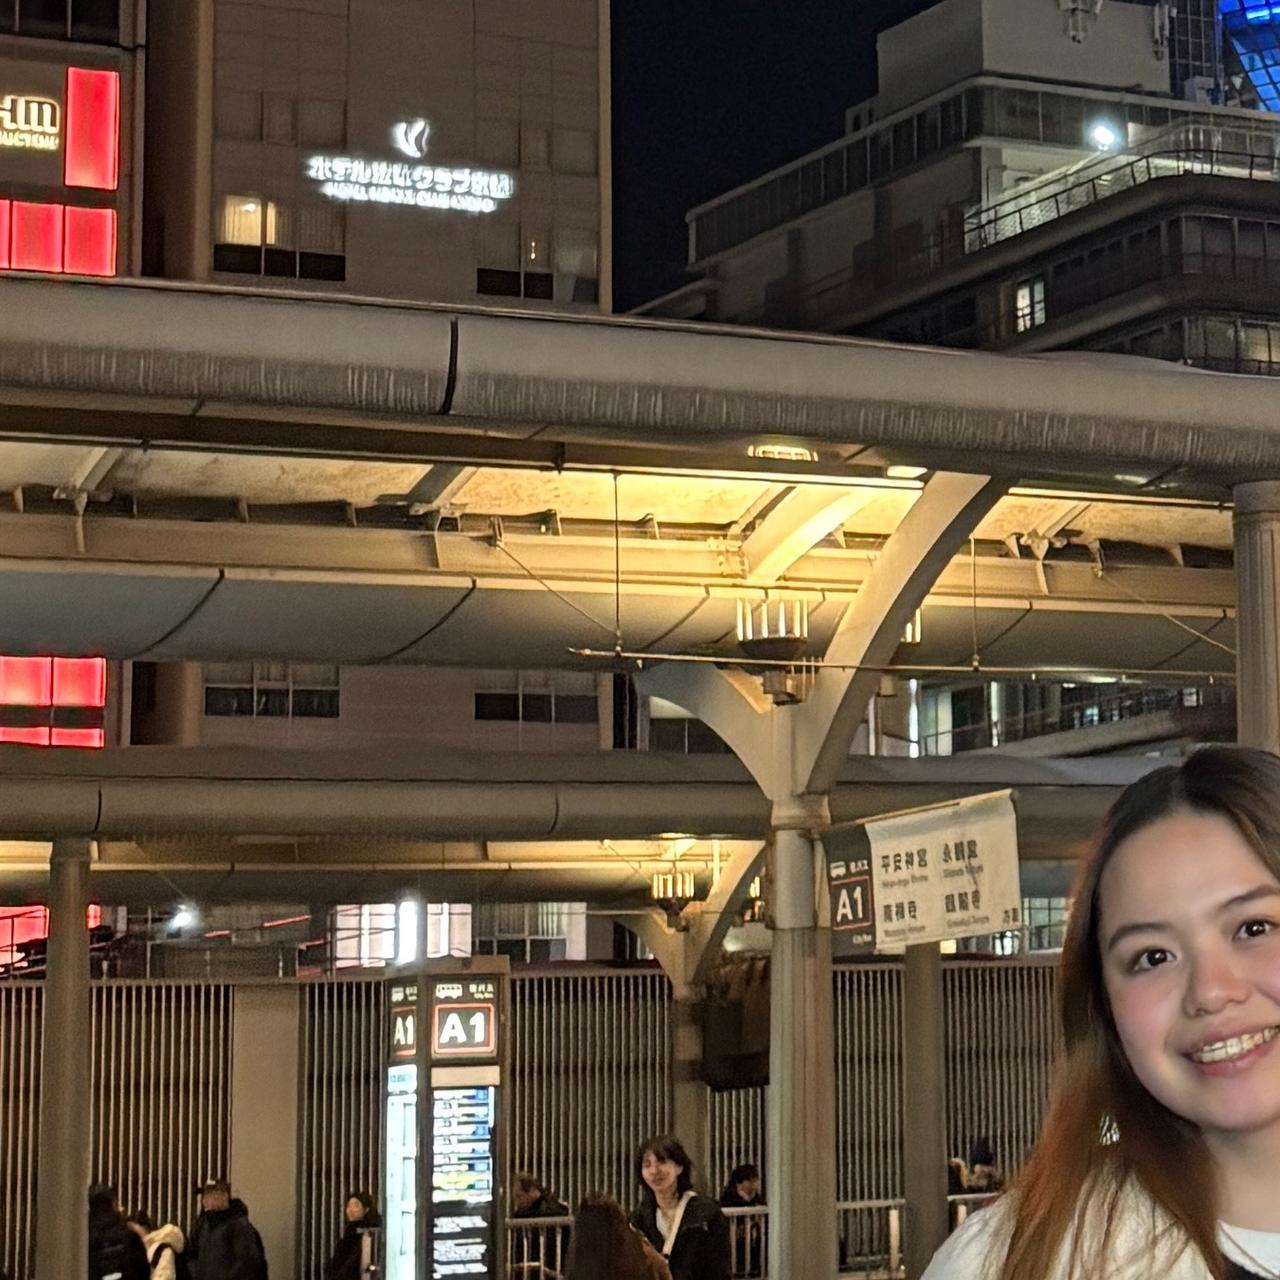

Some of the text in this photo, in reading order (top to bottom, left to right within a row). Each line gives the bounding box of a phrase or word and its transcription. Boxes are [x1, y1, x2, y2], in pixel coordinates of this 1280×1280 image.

[836, 885, 863, 923] A1
[394, 1015, 414, 1045] A1
[439, 1012, 485, 1044] A1
